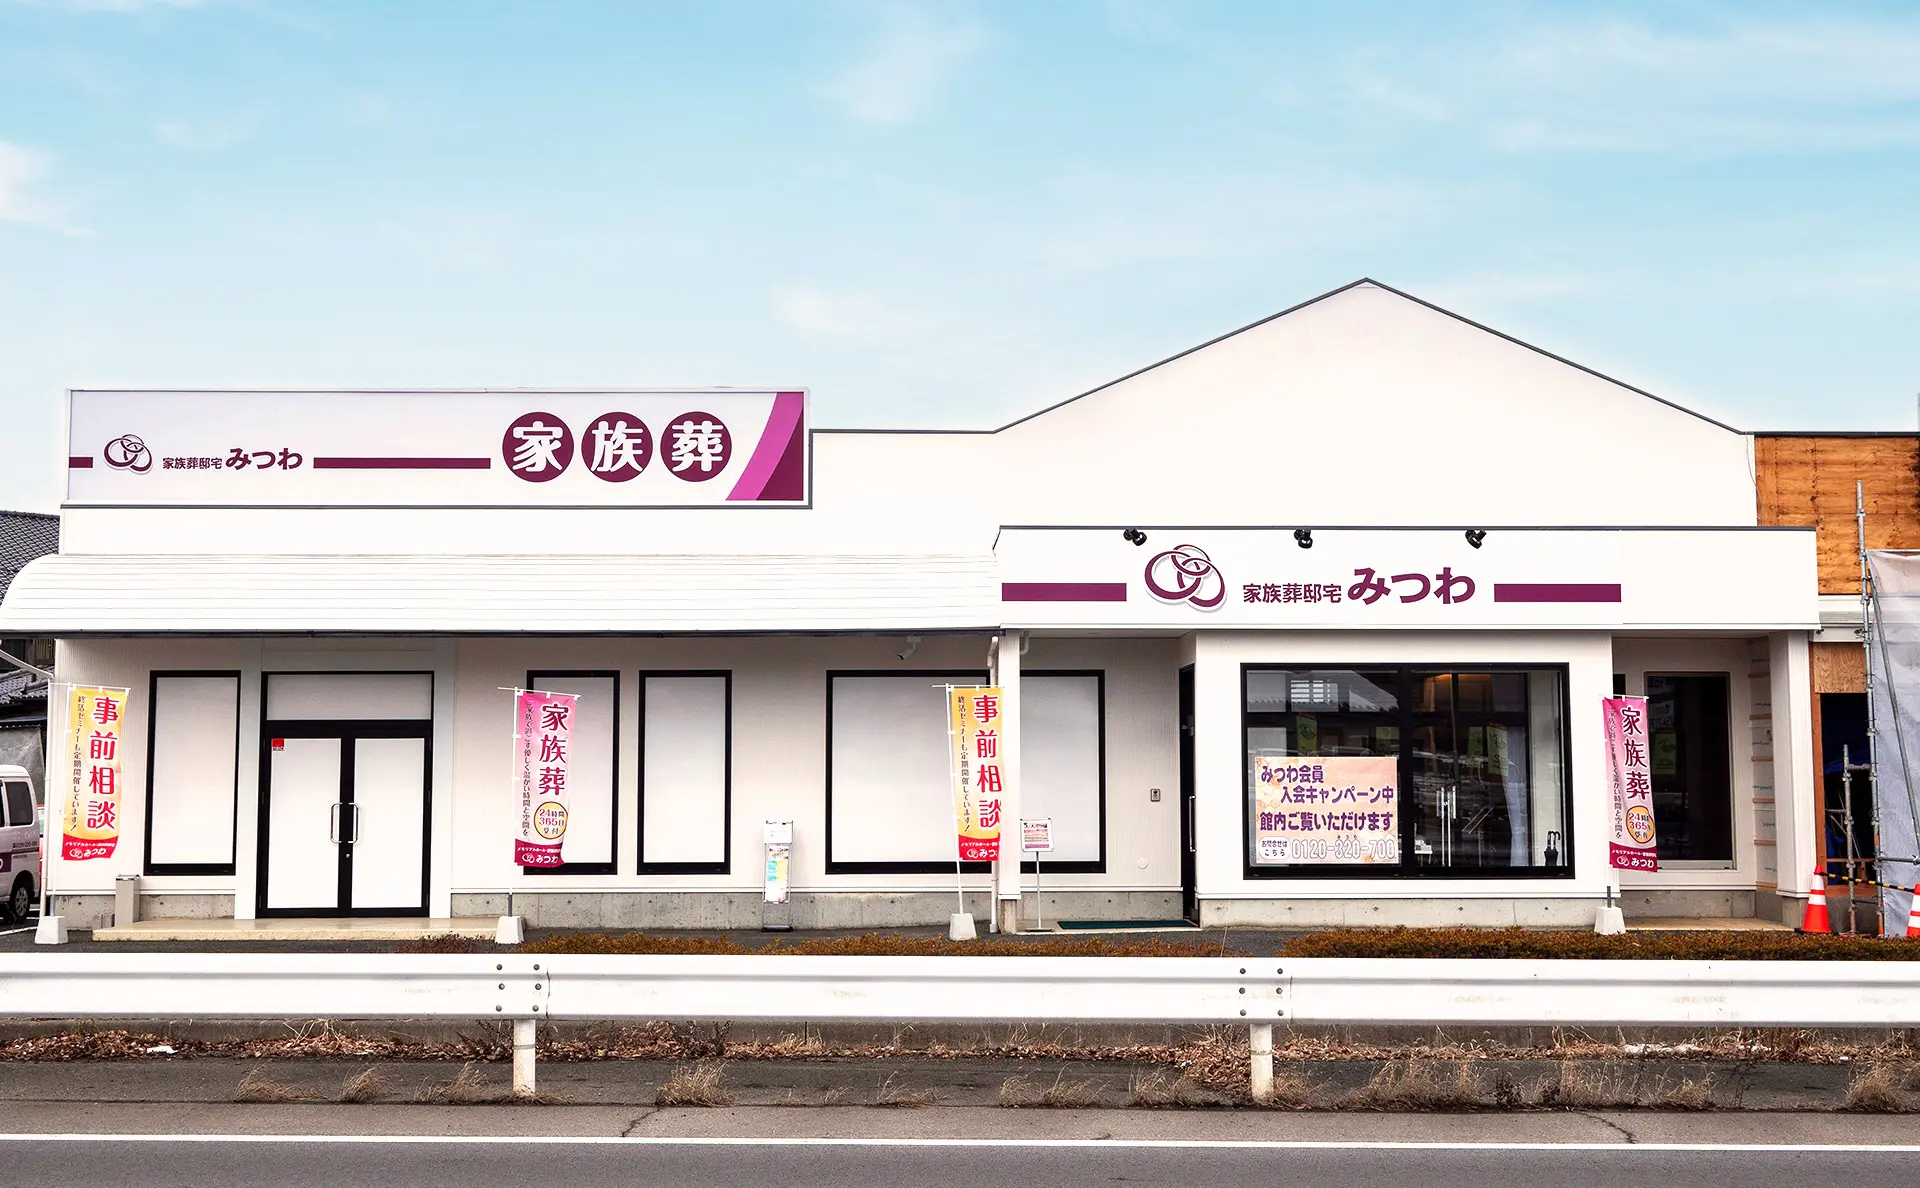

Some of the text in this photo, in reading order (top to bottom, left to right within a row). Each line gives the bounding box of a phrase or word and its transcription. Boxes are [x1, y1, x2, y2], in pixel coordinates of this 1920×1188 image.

[511, 420, 724, 472] 家族葬
[163, 448, 303, 470] 家族葬邸宅 みつわ
[1242, 567, 1476, 605] 家族葬邸宅 みつわ
[539, 703, 570, 796] 家族葬
[1621, 707, 1650, 800] 家族葬
[87, 697, 120, 829] 事前相談
[972, 695, 1002, 828] 事前相談
[1261, 765, 1324, 783] みつわ会員
[1280, 785, 1394, 803] 入会キャンペーン中
[1260, 812, 1394, 831] 館内ご覧いただけます
[84, 848, 107, 857] みつわ
[536, 855, 559, 863] みつわ
[979, 848, 998, 857] みつ
[1292, 839, 1395, 859] 0120-320-700
[1631, 857, 1654, 868] みつわ
